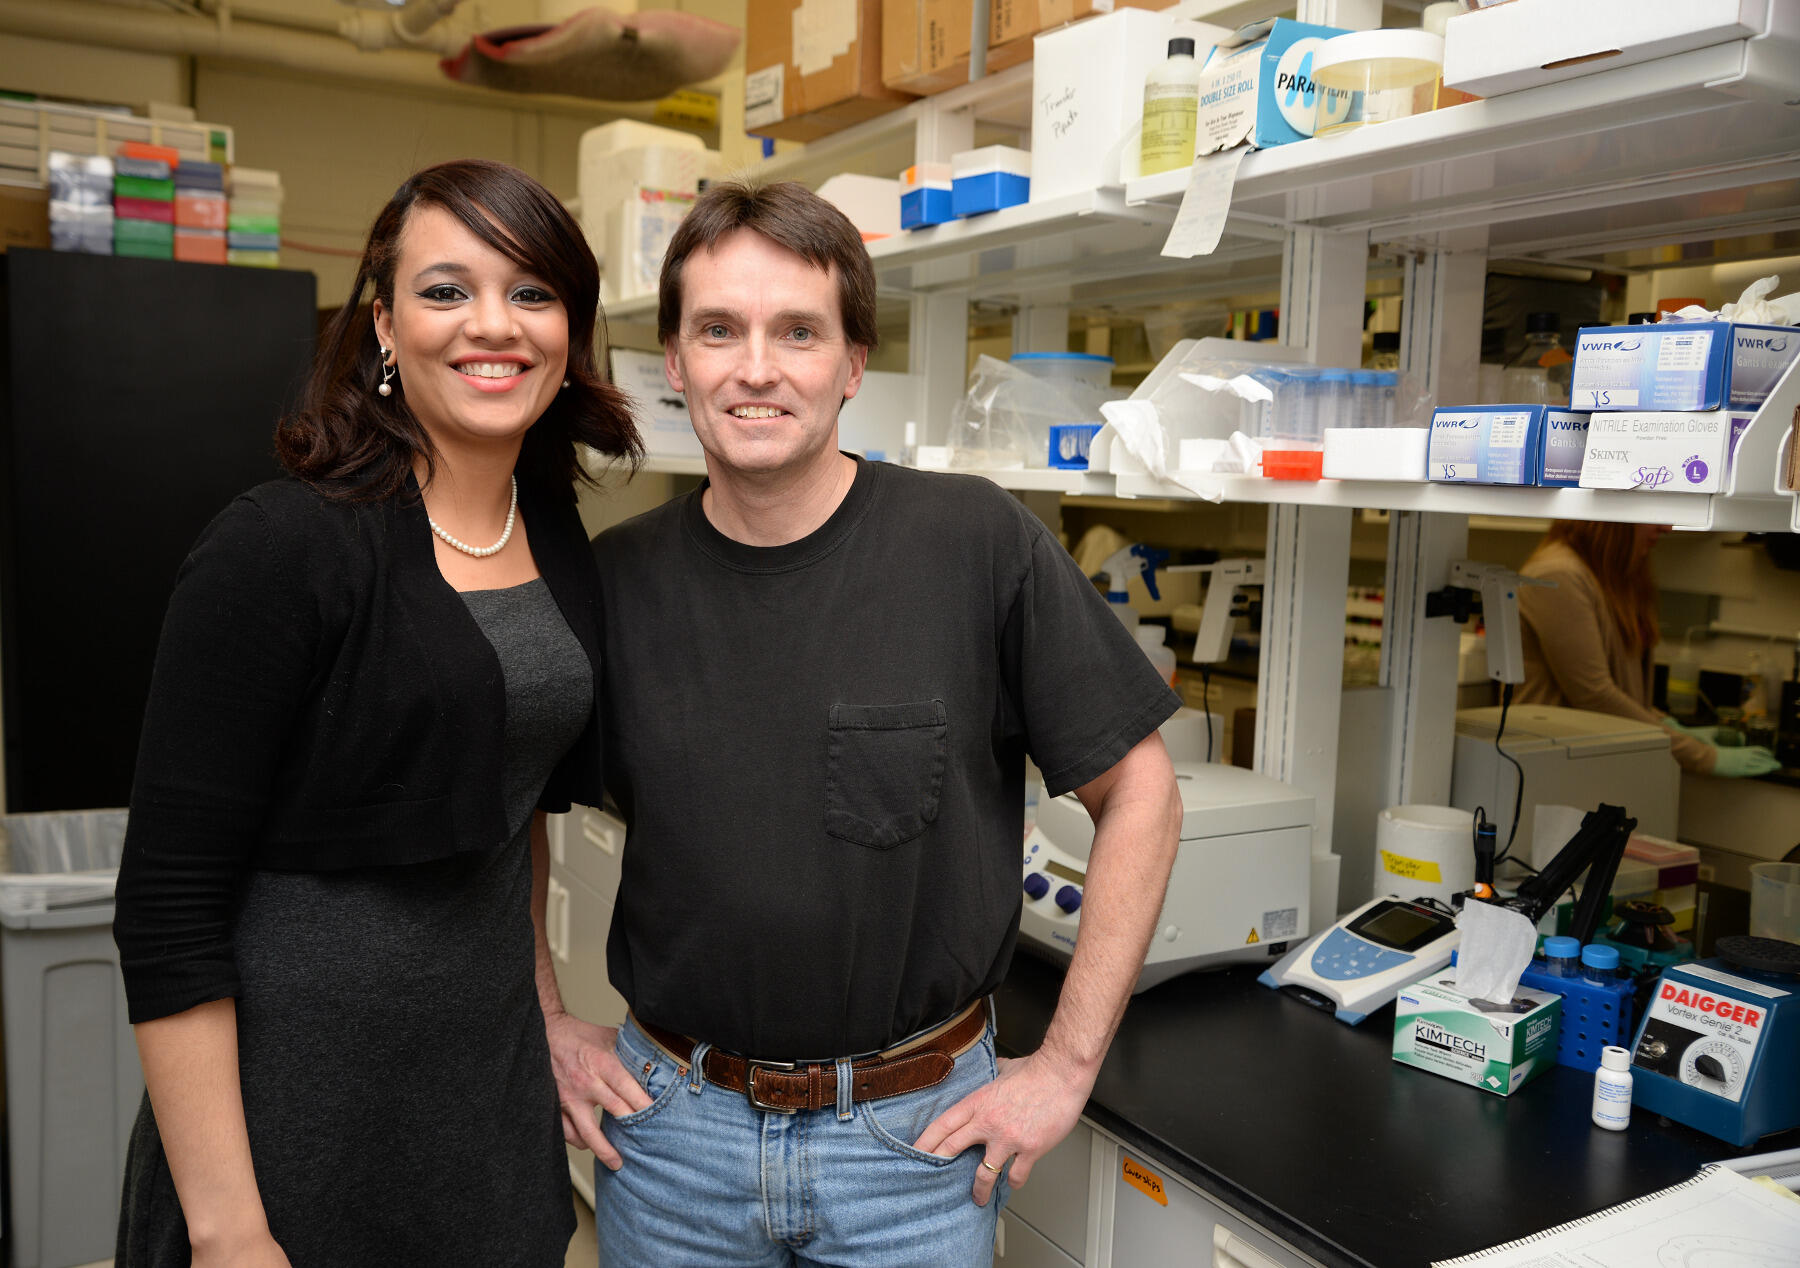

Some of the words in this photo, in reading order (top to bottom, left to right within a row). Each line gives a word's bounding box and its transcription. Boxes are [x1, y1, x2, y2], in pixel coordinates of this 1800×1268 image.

[1200, 88, 1222, 107] DOUBLE
[1223, 83, 1236, 99] SIZE
[1237, 79, 1254, 94] ROLL
[1582, 342, 1612, 351] VWR
[1737, 337, 1764, 349] VWR
[1737, 355, 1760, 369] Gants
[1435, 420, 1458, 429] VWR
[1551, 420, 1582, 432] VWR
[1592, 418, 1629, 433] NITRILE
[1632, 419, 1686, 433] Examination
[1687, 418, 1720, 433] Gloves
[1550, 436, 1577, 448] Gants
[1633, 465, 1670, 489] Soft
[1693, 466, 1701, 477] L
[1660, 983, 1761, 1029] DAIGGER
[1527, 1014, 1553, 1038] KIMTECH
[1667, 1003, 1698, 1022] Vortex
[1734, 1025, 1743, 1036] 2
[1505, 1026, 1510, 1037] 1
[1415, 1024, 1486, 1056] KIMTECH
